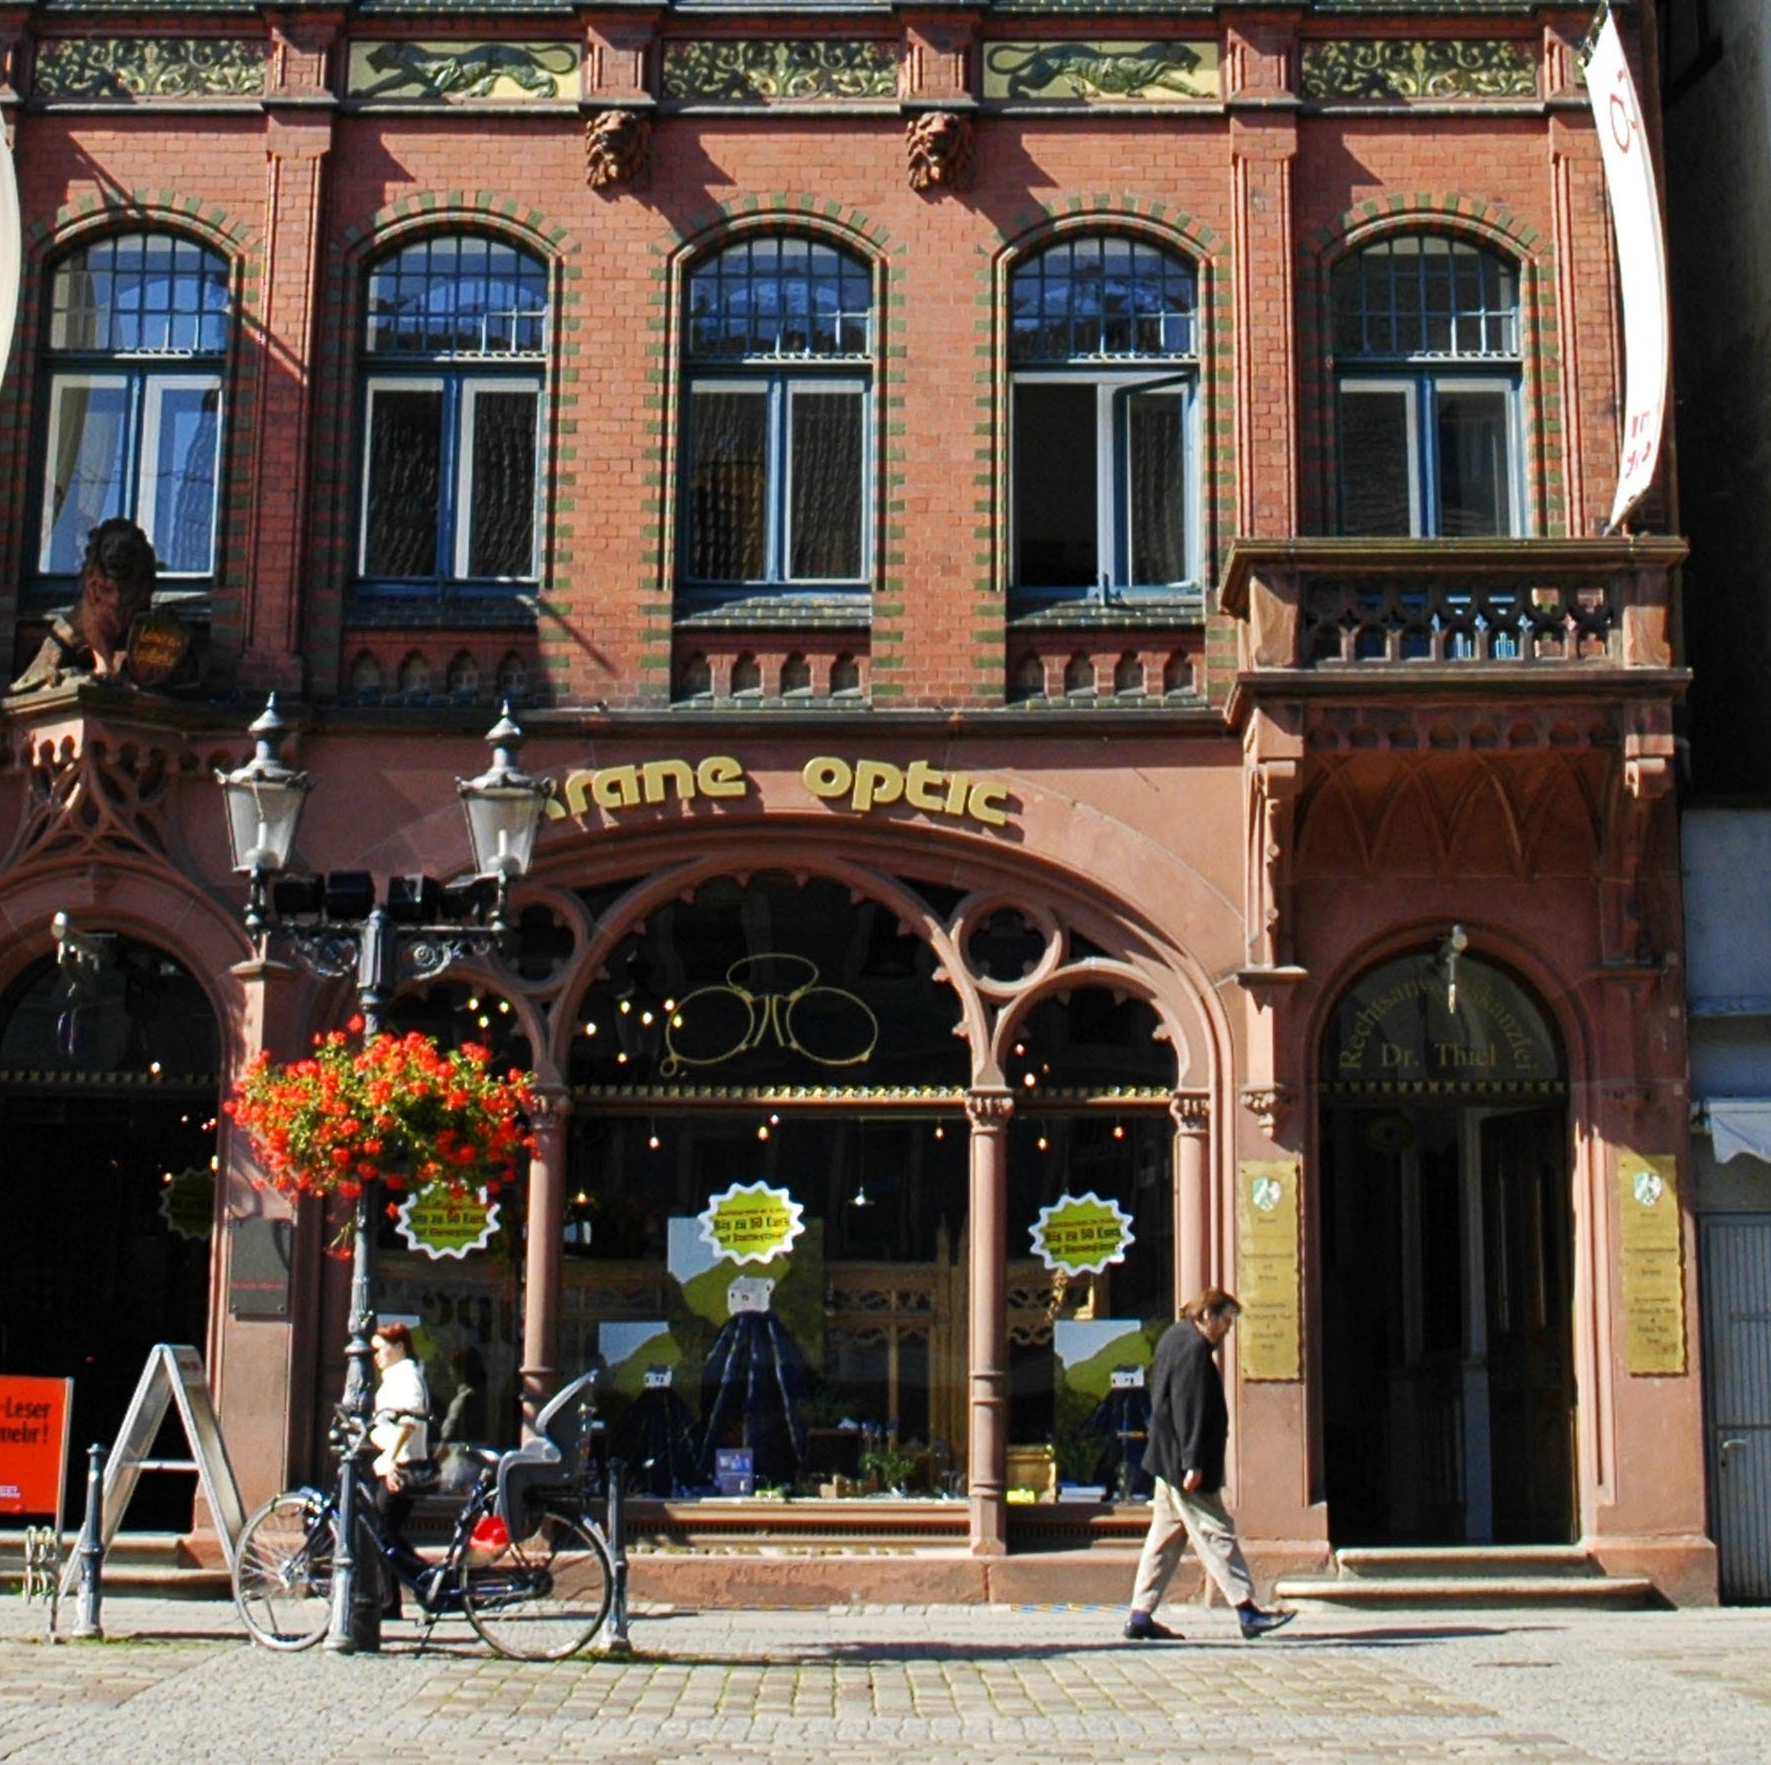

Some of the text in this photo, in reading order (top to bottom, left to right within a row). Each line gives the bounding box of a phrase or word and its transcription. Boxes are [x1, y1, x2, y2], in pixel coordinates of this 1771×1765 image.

[542, 756, 1009, 826] rane optic
[1381, 1042, 1497, 1068] Dr. Thiel
